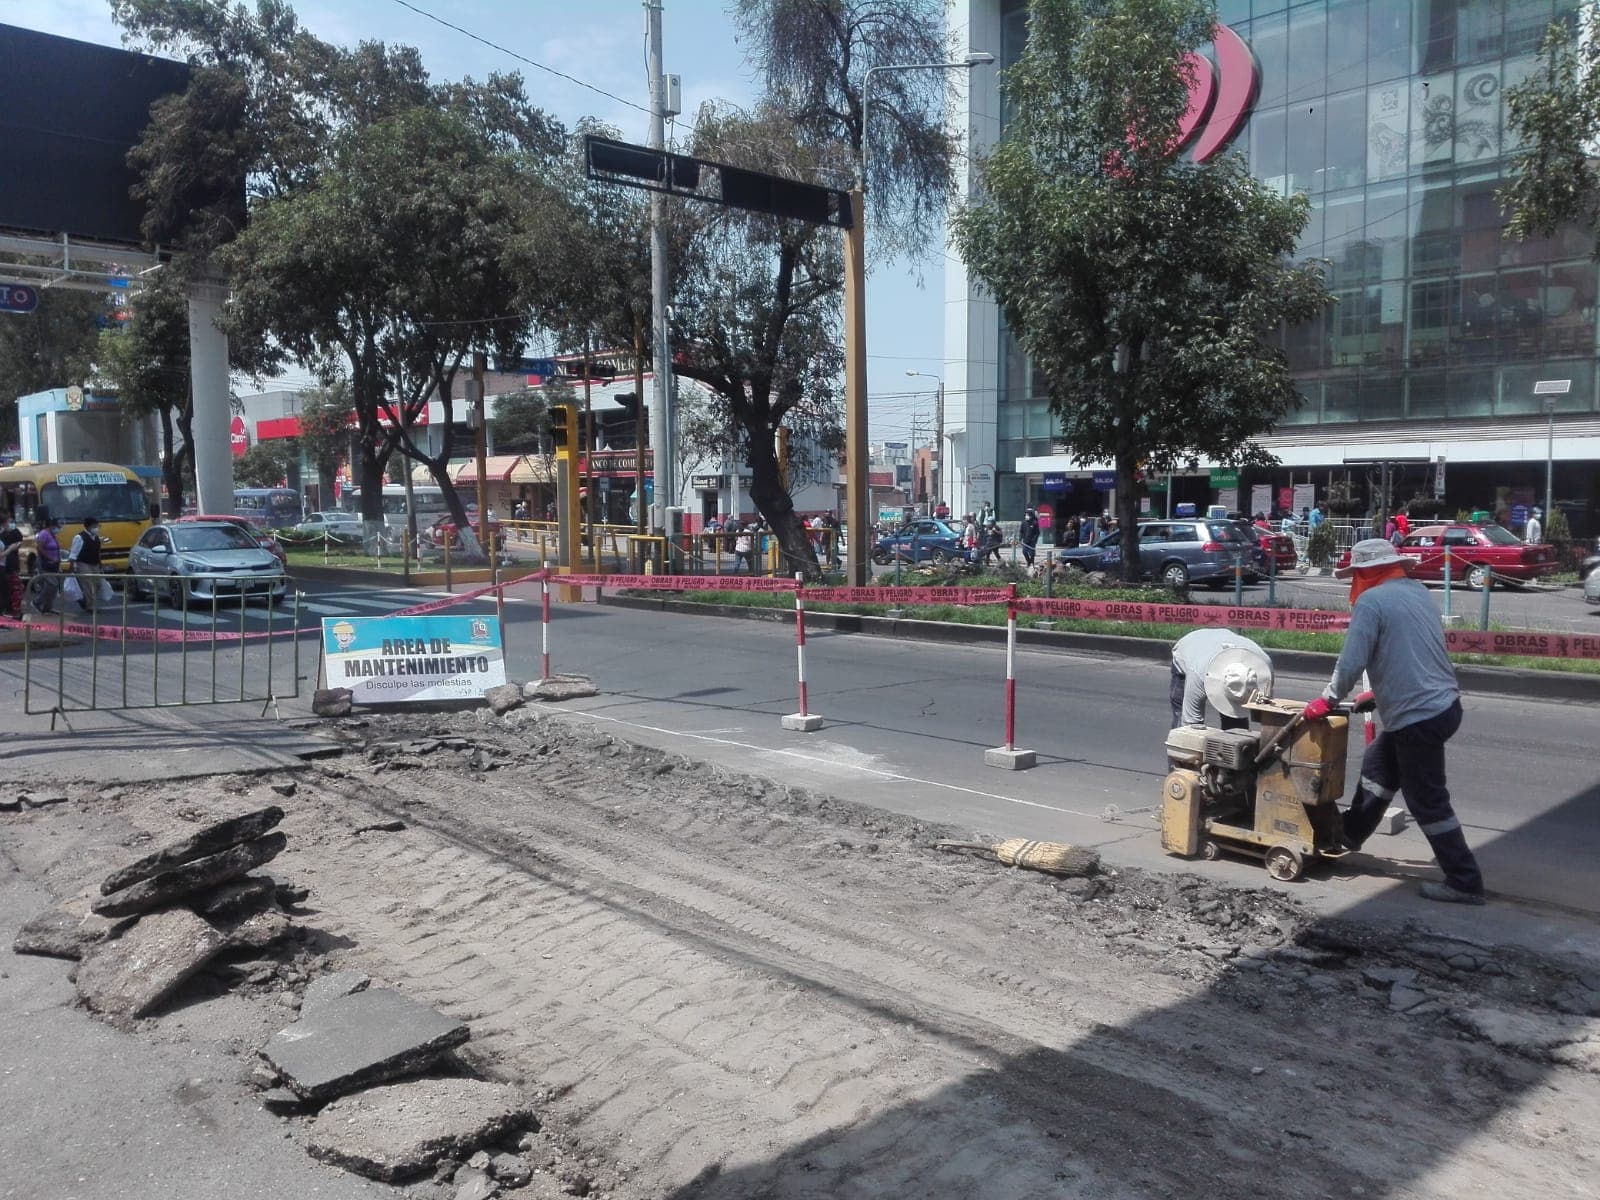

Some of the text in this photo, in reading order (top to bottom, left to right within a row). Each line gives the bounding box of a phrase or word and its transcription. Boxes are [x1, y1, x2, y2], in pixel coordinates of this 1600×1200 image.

[681, 577, 705, 585] PELIGRO
[720, 578, 744, 586] OBRAS
[851, 588, 875, 597] OBRAS
[886, 588, 912, 598] PELIGRO
[930, 588, 959, 597] OBRAS
[1045, 600, 1081, 613] PELIGRO
[1105, 603, 1143, 615] OBRAS
[1158, 606, 1199, 619] PELIGRO
[1227, 609, 1271, 621] OBRAS
[1289, 612, 1336, 625] PELIGRO
[382, 638, 452, 656] AREA DE
[1494, 635, 1600, 651] OBRAS PEL
[345, 656, 489, 677] MANTENIMIENTO
[366, 678, 472, 690] Disculpe las molestias
